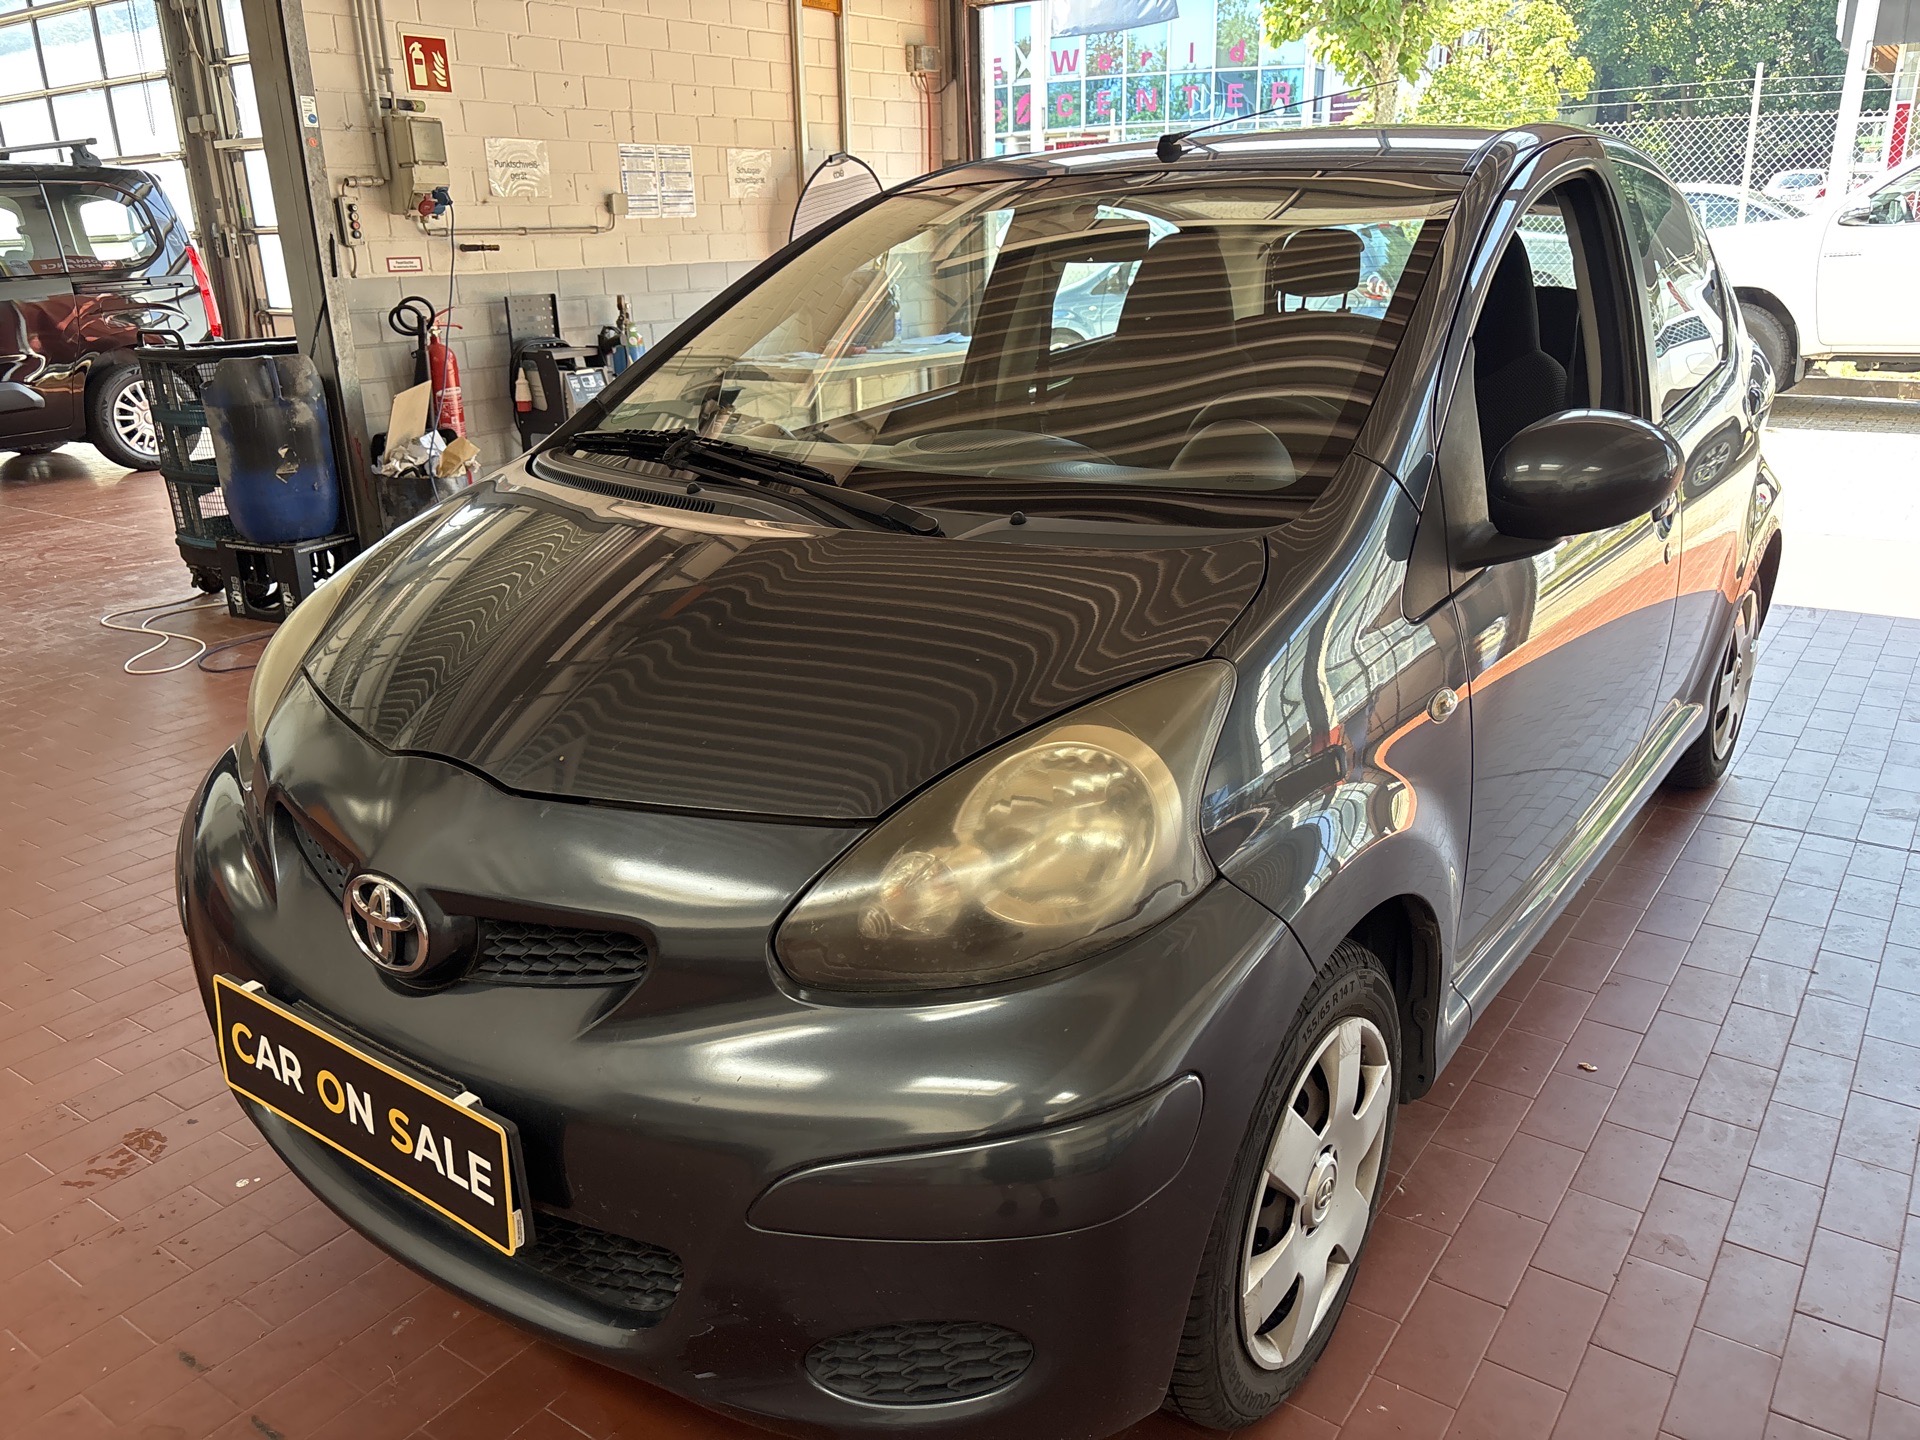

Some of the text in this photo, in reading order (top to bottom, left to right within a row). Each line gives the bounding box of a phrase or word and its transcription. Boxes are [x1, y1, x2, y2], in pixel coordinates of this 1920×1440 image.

[1056, 82, 1291, 118] CENTER
[1302, 1000, 1330, 1043] 155/65
[1332, 992, 1339, 1007] R
[231, 1022, 495, 1207] CAR ON SALE
